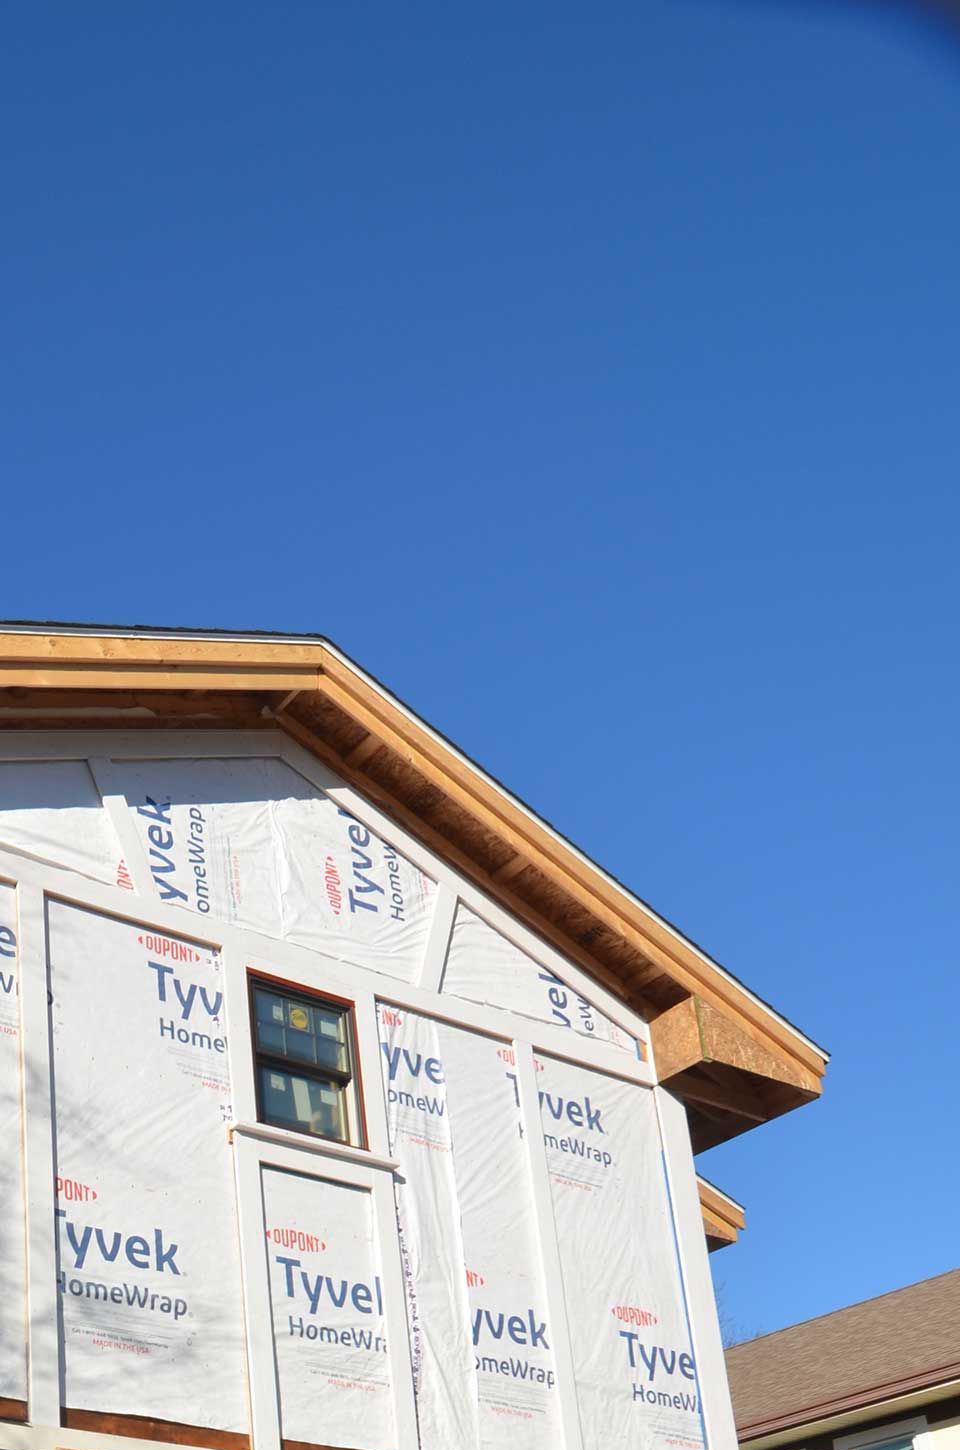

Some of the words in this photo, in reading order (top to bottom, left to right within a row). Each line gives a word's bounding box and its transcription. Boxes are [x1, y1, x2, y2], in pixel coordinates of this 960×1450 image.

[137, 795, 188, 901] yvek
[187, 807, 210, 913] omeWrap
[325, 862, 341, 910] DUPONT
[146, 936, 193, 963] DUPONT
[148, 961, 223, 1020] Tyv
[160, 1017, 228, 1053] Home
[380, 1042, 445, 1084] yve
[273, 1228, 319, 1253] DUPONT
[617, 1306, 652, 1327] DUPONT
[619, 1330, 697, 1382] Tyve
